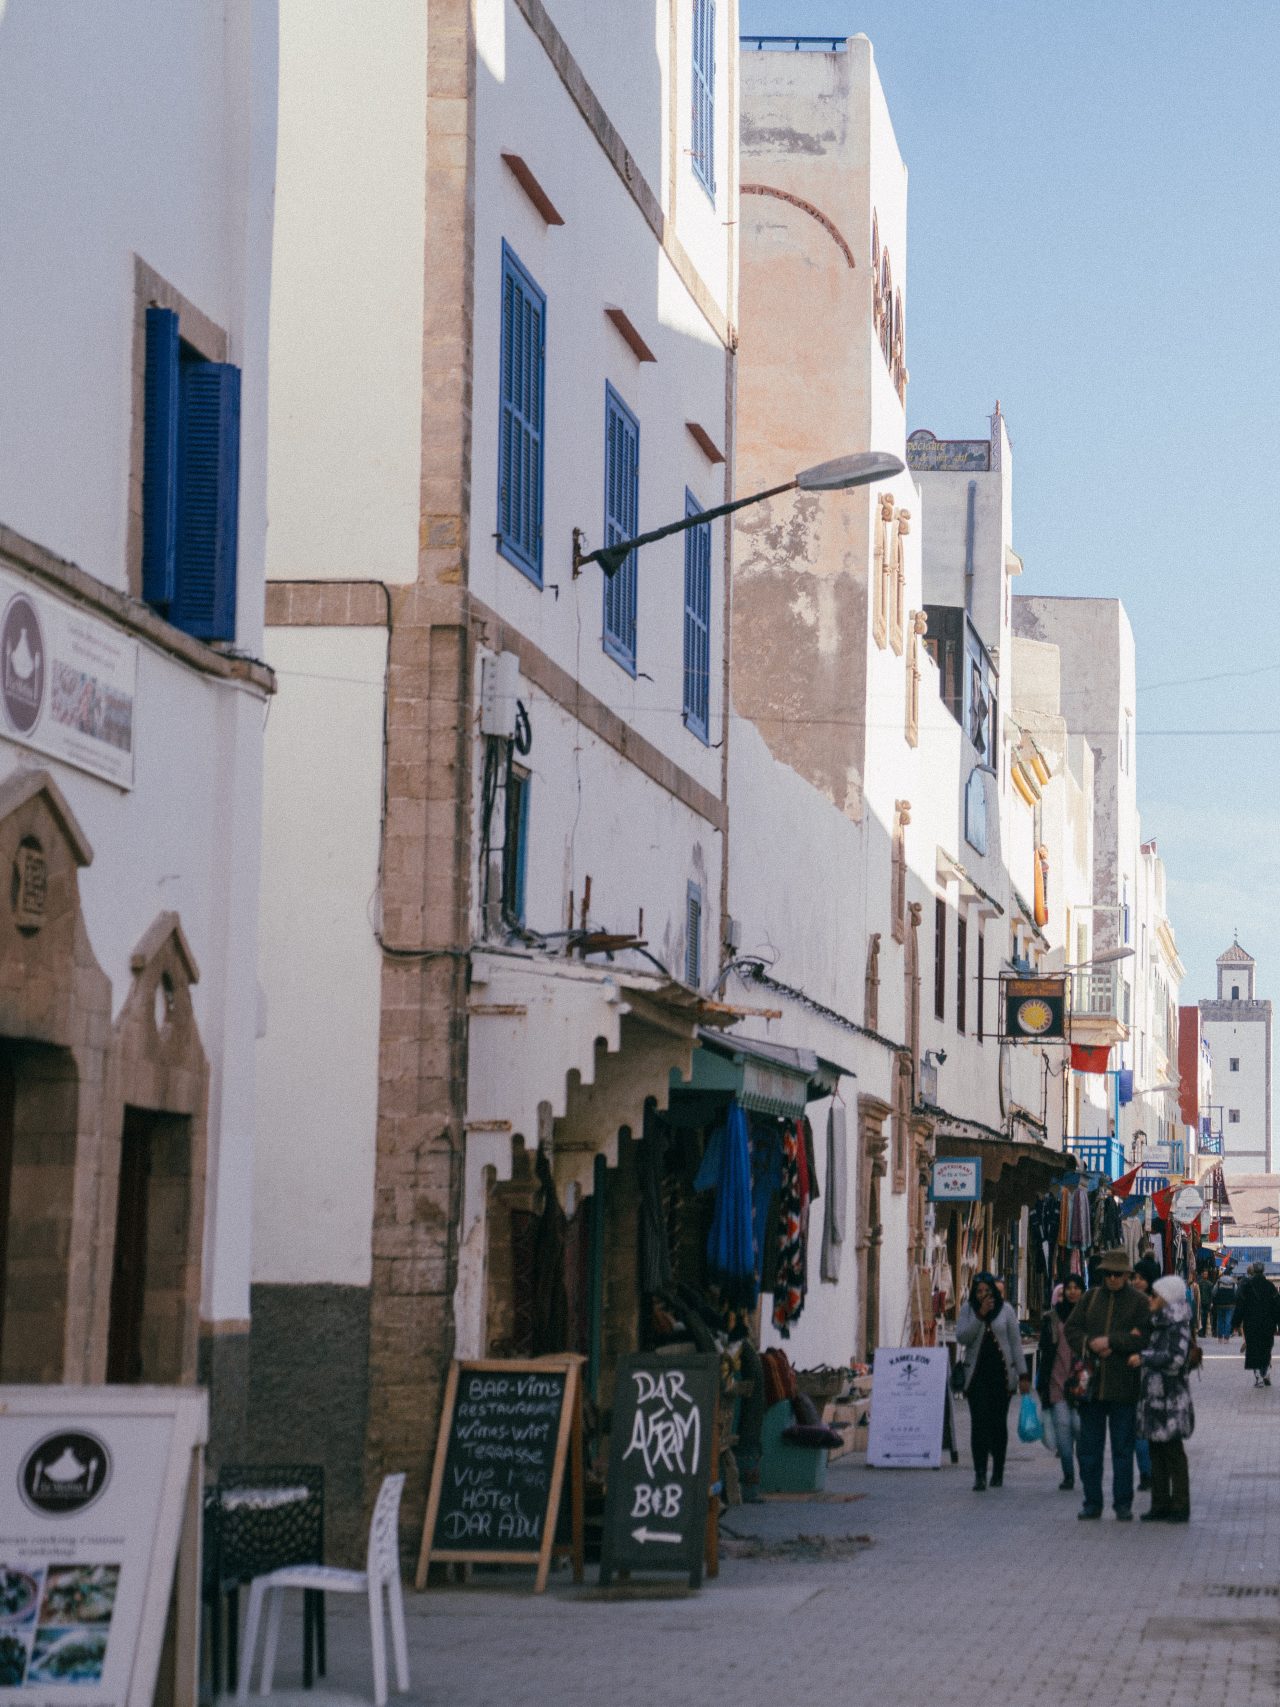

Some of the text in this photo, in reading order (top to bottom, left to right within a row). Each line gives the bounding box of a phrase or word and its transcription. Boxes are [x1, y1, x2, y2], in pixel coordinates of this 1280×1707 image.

[889, 1354, 931, 1366] KAMELEON
[632, 1370, 694, 1411] DAR
[630, 1483, 683, 1519] B&B
[443, 1511, 492, 1539] DAR
